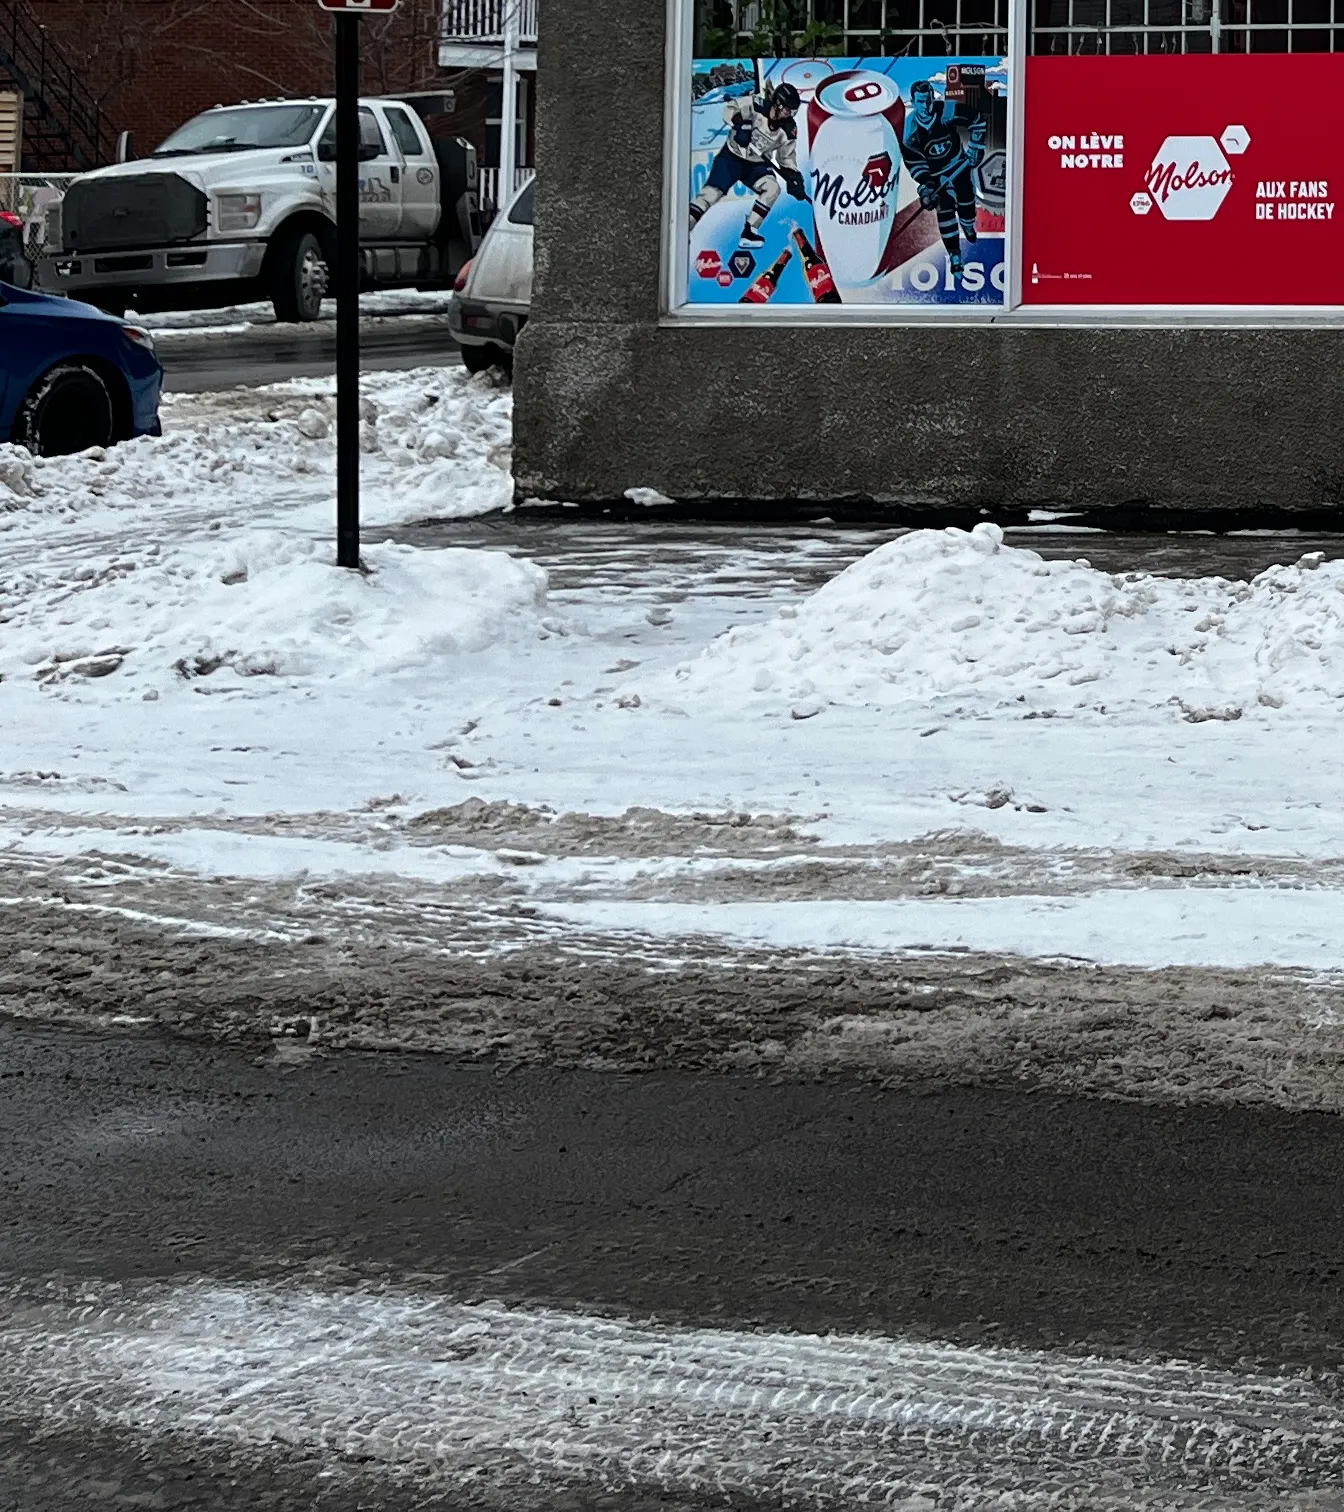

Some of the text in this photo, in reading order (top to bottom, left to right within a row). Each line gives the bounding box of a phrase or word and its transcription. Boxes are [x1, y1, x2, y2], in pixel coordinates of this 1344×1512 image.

[1048, 131, 1124, 151] ON LÈVE
[1061, 153, 1124, 169] NOTRE
[1144, 160, 1236, 202] Molson
[1256, 180, 1328, 198] AUX FANS
[810, 166, 901, 220] Molson
[1256, 202, 1335, 220] DE HOCKEY
